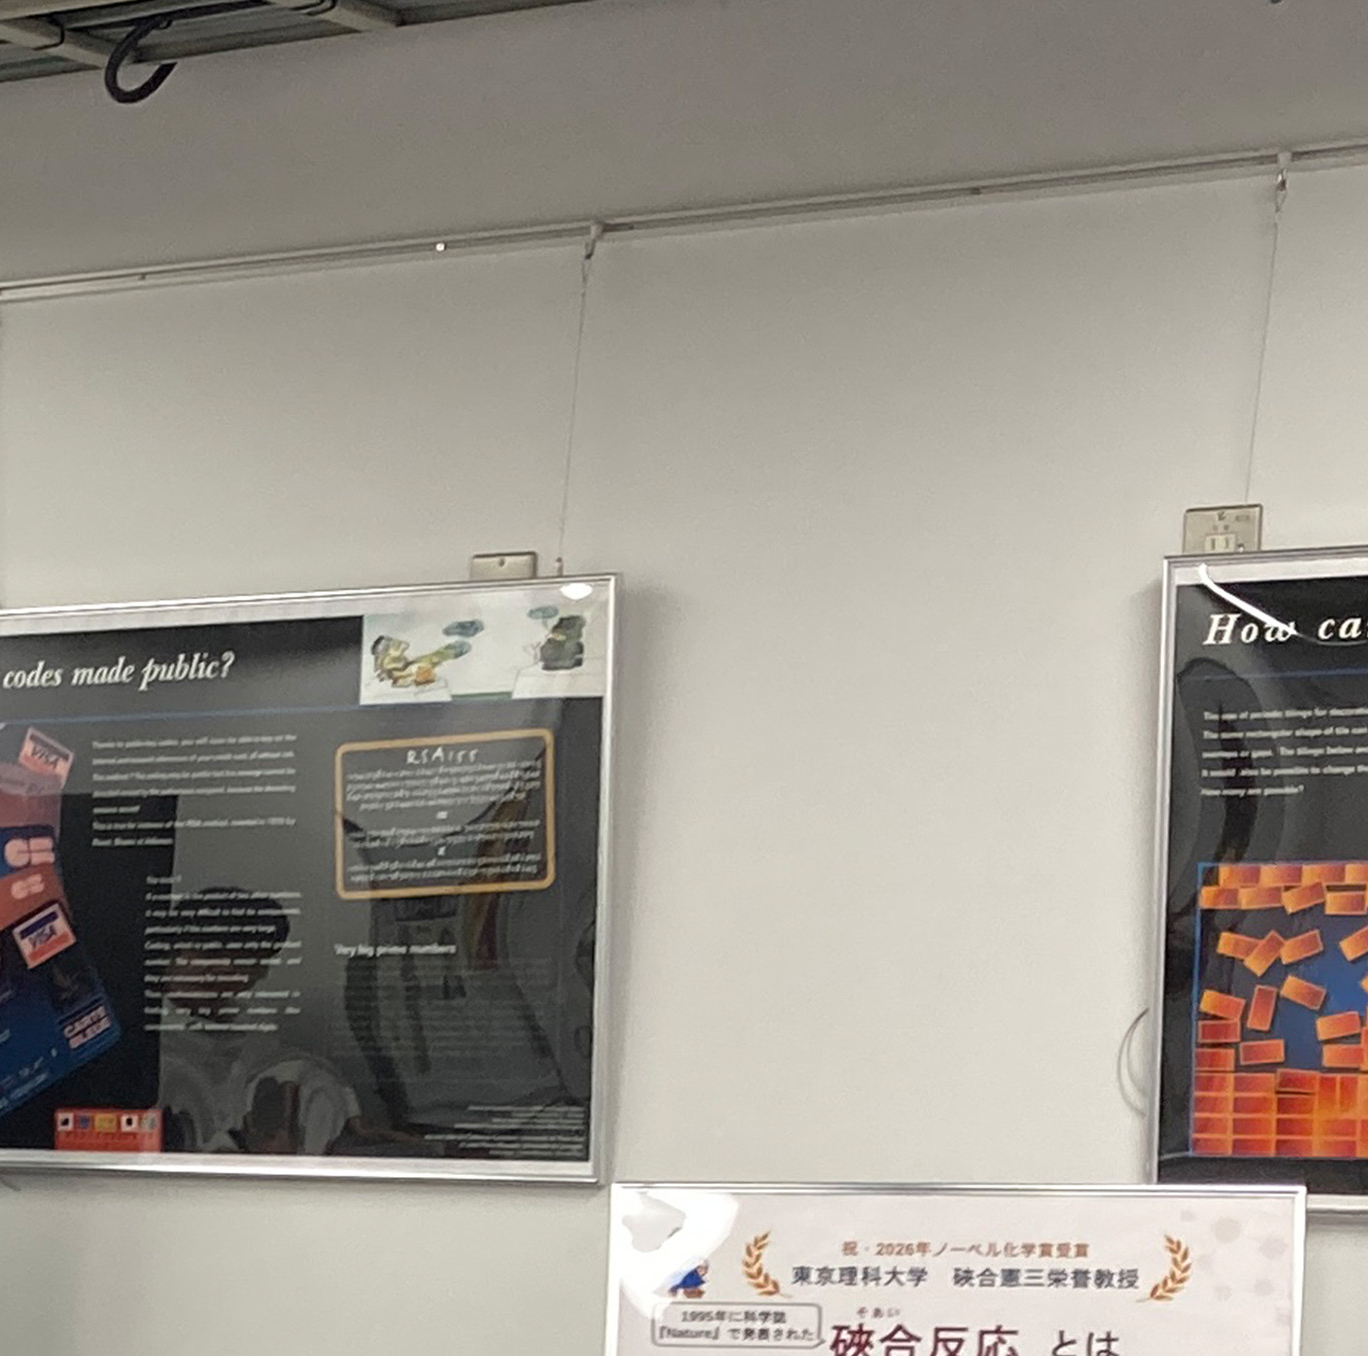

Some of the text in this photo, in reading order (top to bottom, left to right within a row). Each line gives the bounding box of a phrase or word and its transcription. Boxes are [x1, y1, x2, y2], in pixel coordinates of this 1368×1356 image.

[1202, 613, 1368, 645] How ca
[2, 661, 63, 688] codes
[71, 656, 135, 686] made
[138, 651, 235, 691] public?
[791, 1265, 928, 1287] 東京理科大学
